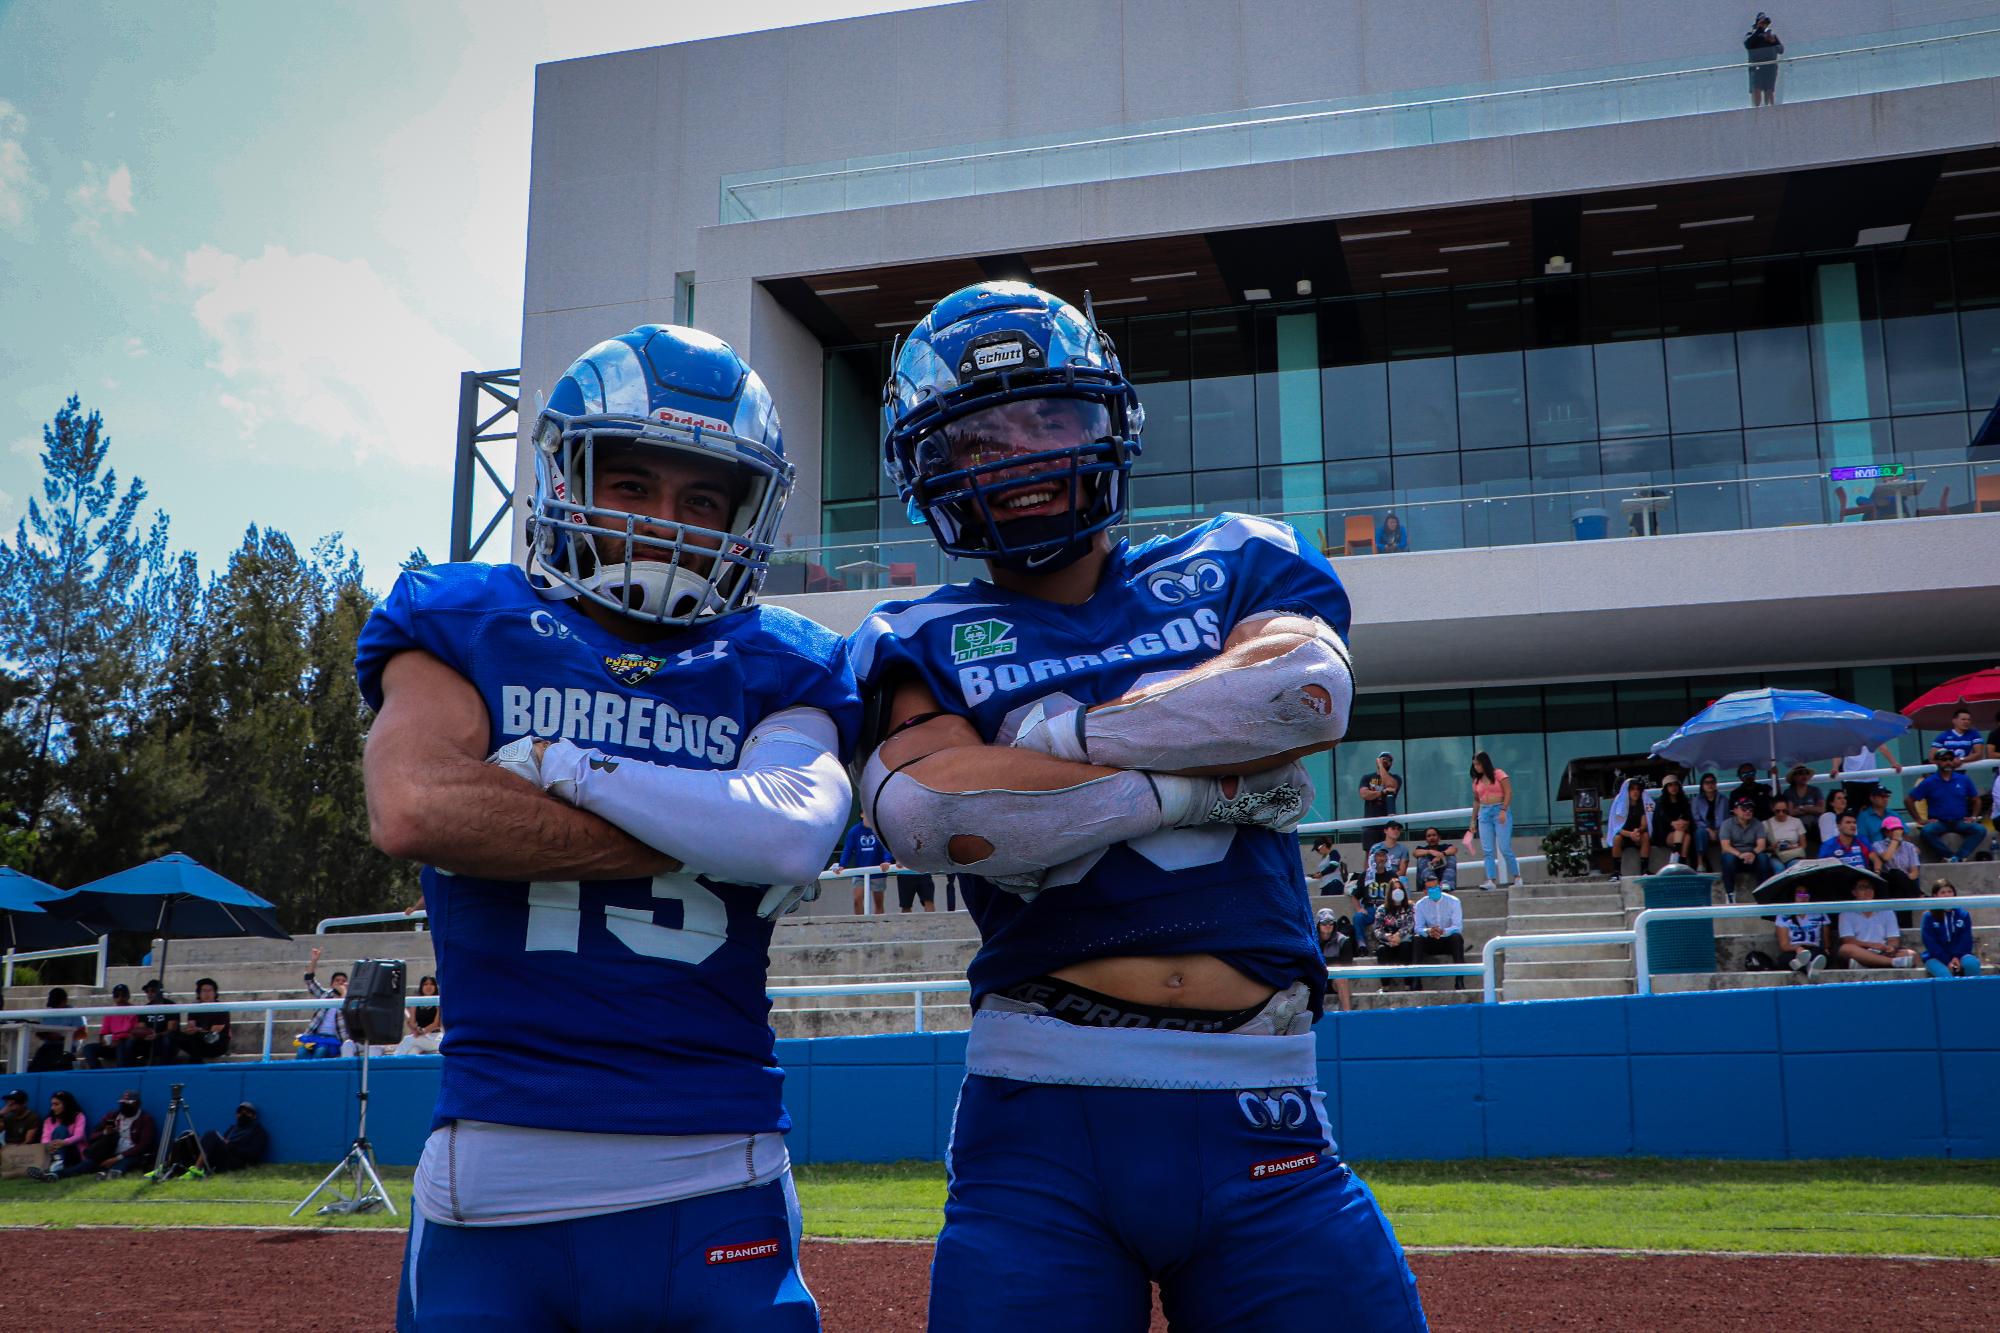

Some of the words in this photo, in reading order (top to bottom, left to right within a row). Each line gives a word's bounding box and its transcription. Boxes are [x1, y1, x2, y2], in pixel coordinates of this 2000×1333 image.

[958, 608, 1221, 708] BORREGOS
[502, 685, 740, 765] BORREGOS
[1053, 993, 1151, 1028] PRO
[1267, 1155, 1317, 1173] BANORTE
[726, 1243, 779, 1259] BANORTE
